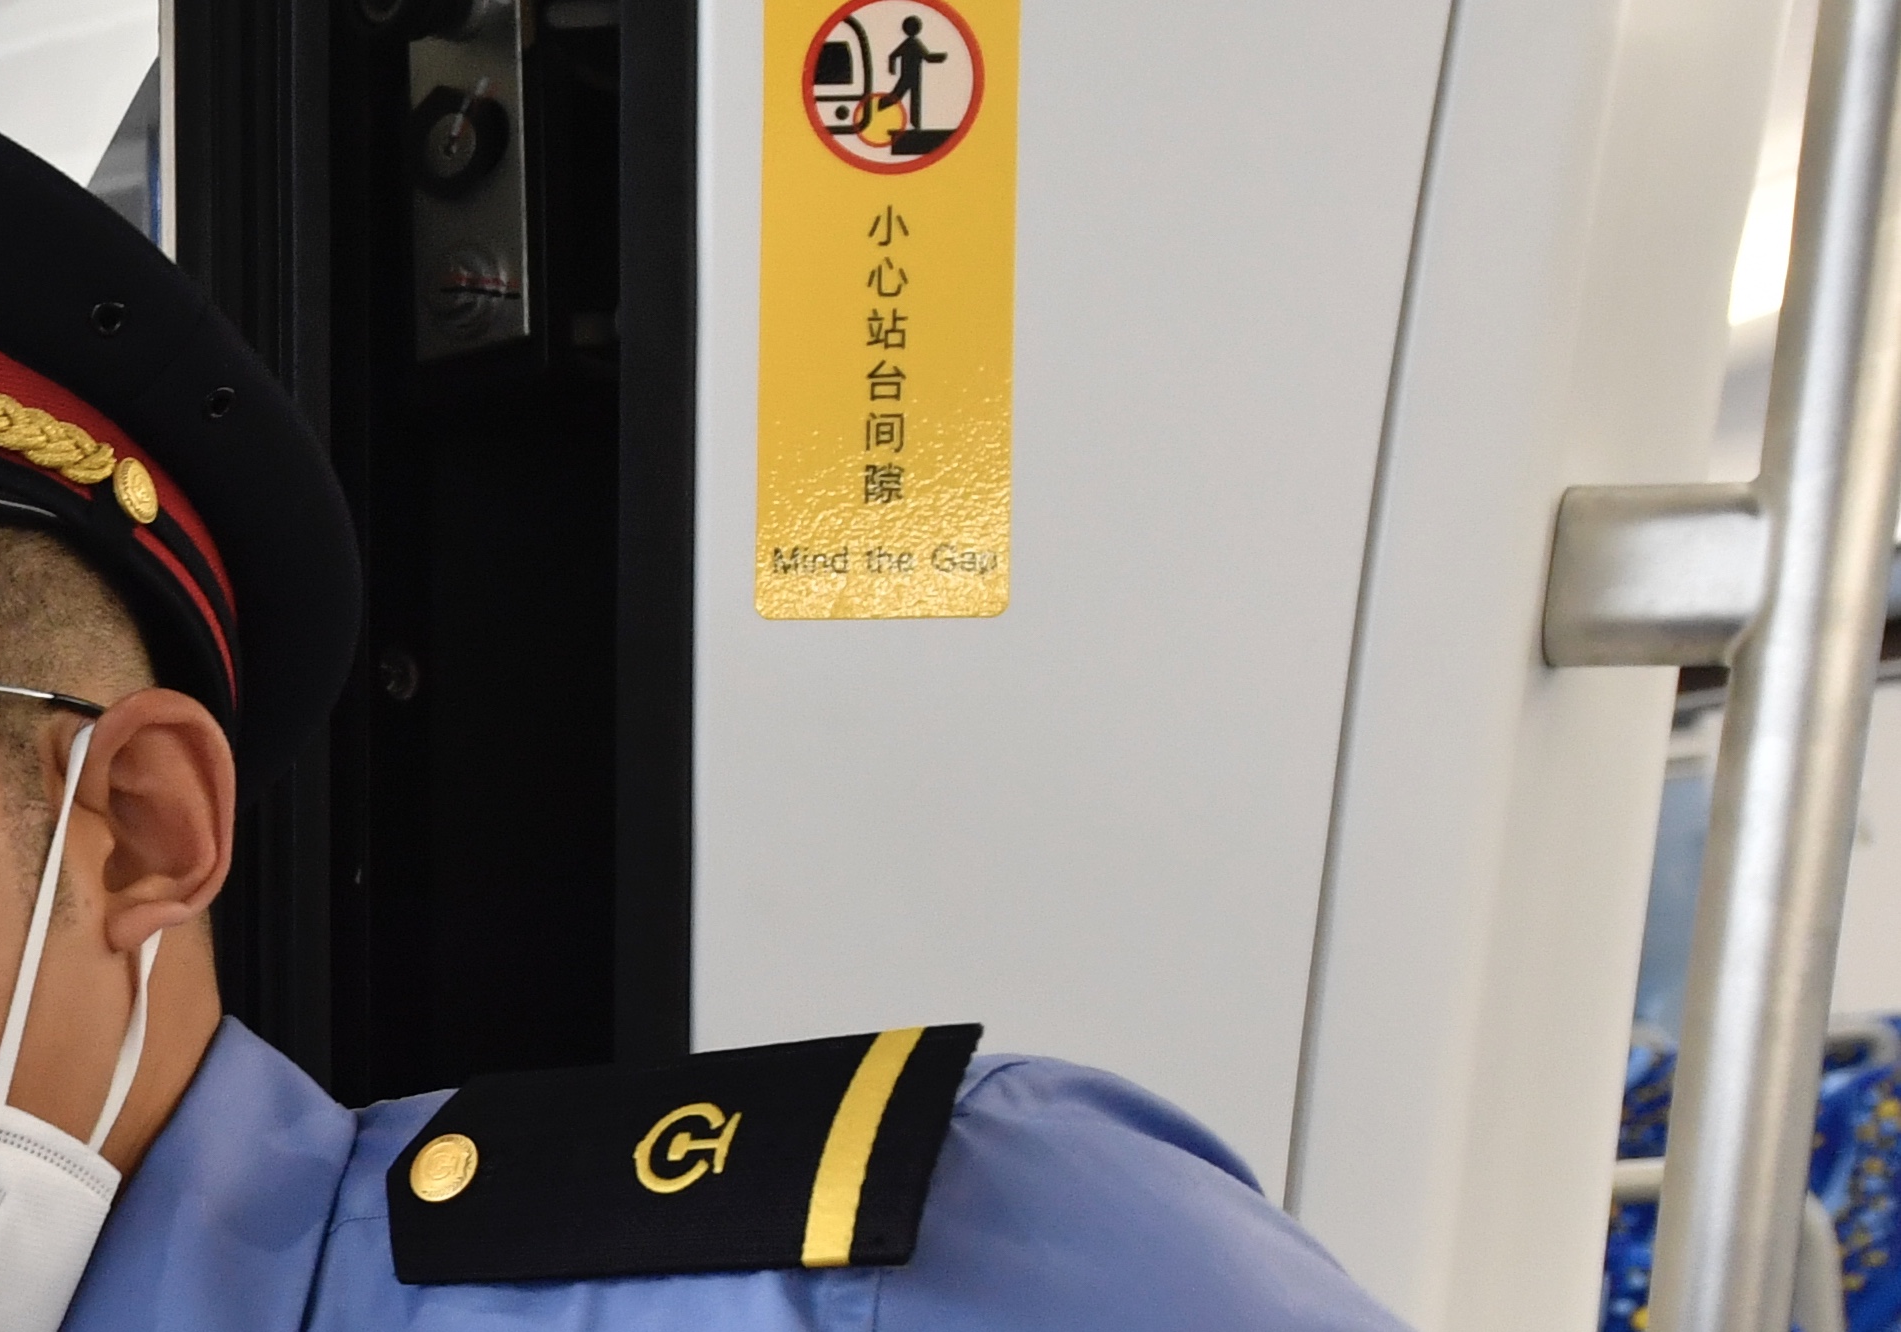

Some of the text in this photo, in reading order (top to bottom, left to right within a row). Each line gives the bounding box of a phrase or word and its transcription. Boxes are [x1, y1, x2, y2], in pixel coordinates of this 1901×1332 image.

[863, 204, 910, 505] 小心站台间隙
[772, 545, 998, 576] Mind the Gap
